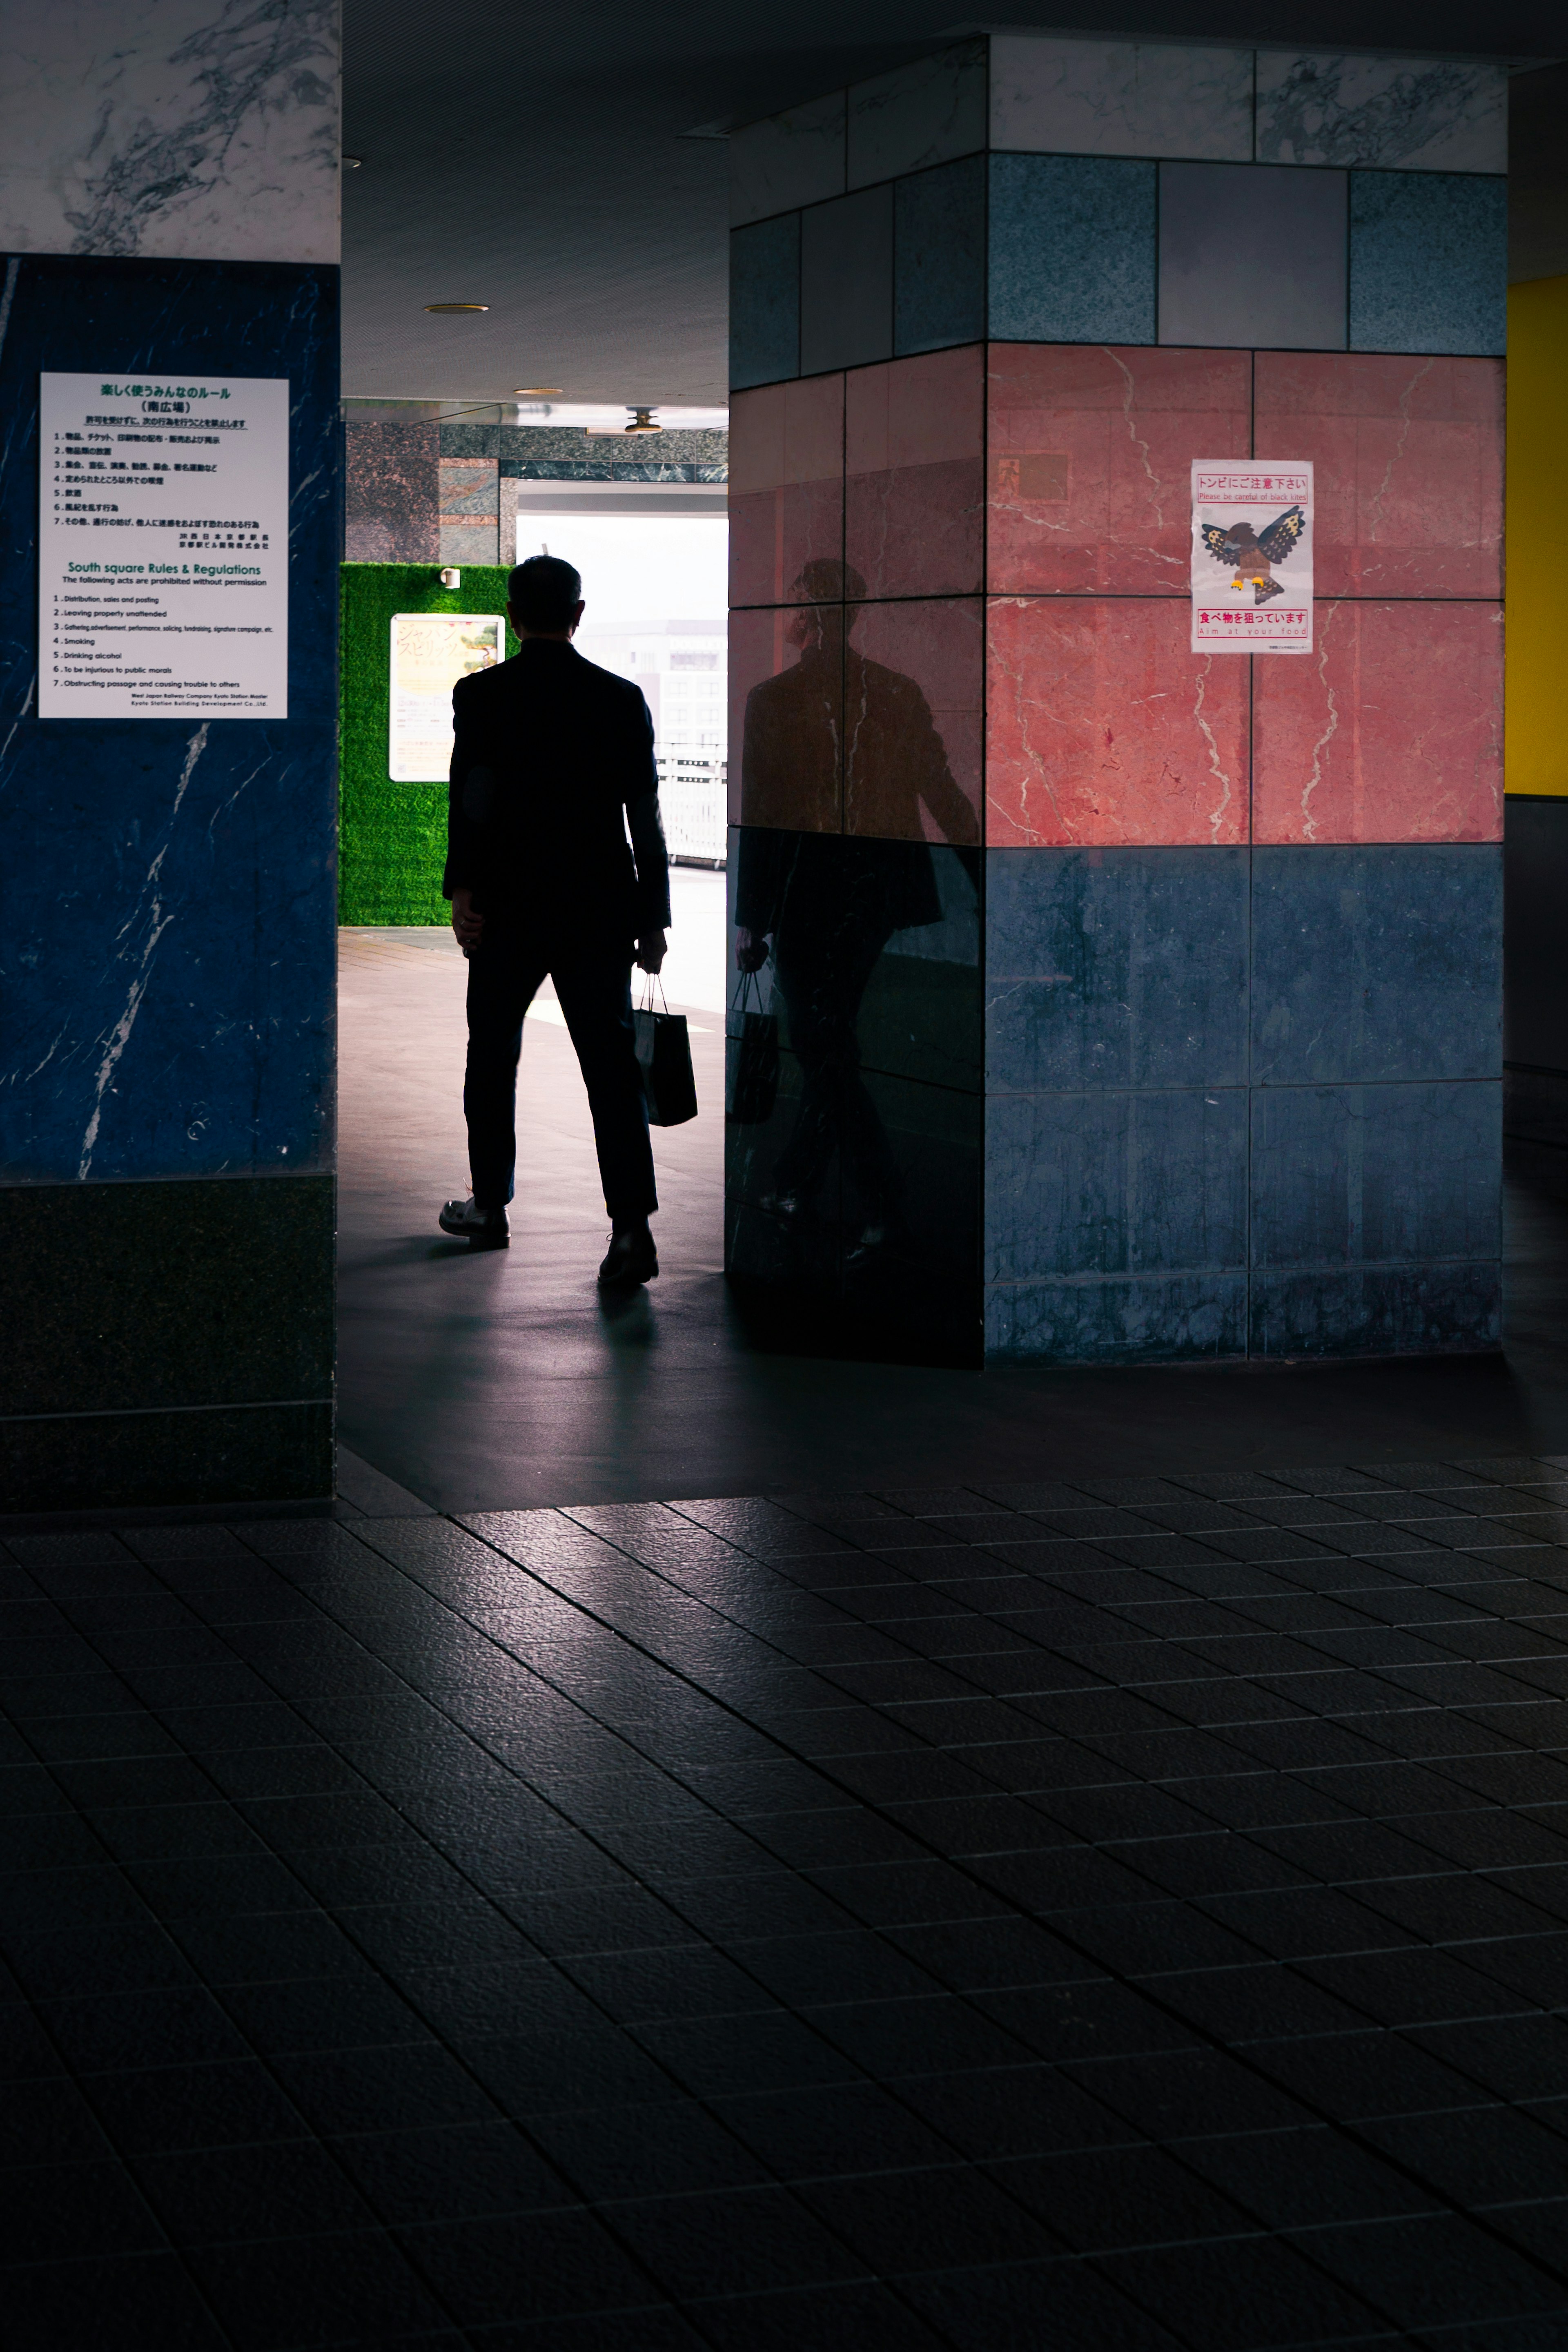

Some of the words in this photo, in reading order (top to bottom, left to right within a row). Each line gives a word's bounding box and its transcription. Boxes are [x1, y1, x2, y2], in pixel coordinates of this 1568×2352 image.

[101, 383, 231, 399] 楽しく使うみんなのルール
[1200, 477, 1307, 489] トンビにご注意下さい
[68, 562, 100, 572] South
[105, 564, 144, 575] square
[149, 564, 178, 573] Rules
[182, 564, 189, 574] &
[194, 564, 261, 577] Regulations
[79, 577, 115, 585] following
[1200, 612, 1305, 624] 食べ物を狙っています
[399, 624, 457, 642] ジャパン
[398, 640, 458, 658] スピリッツ
